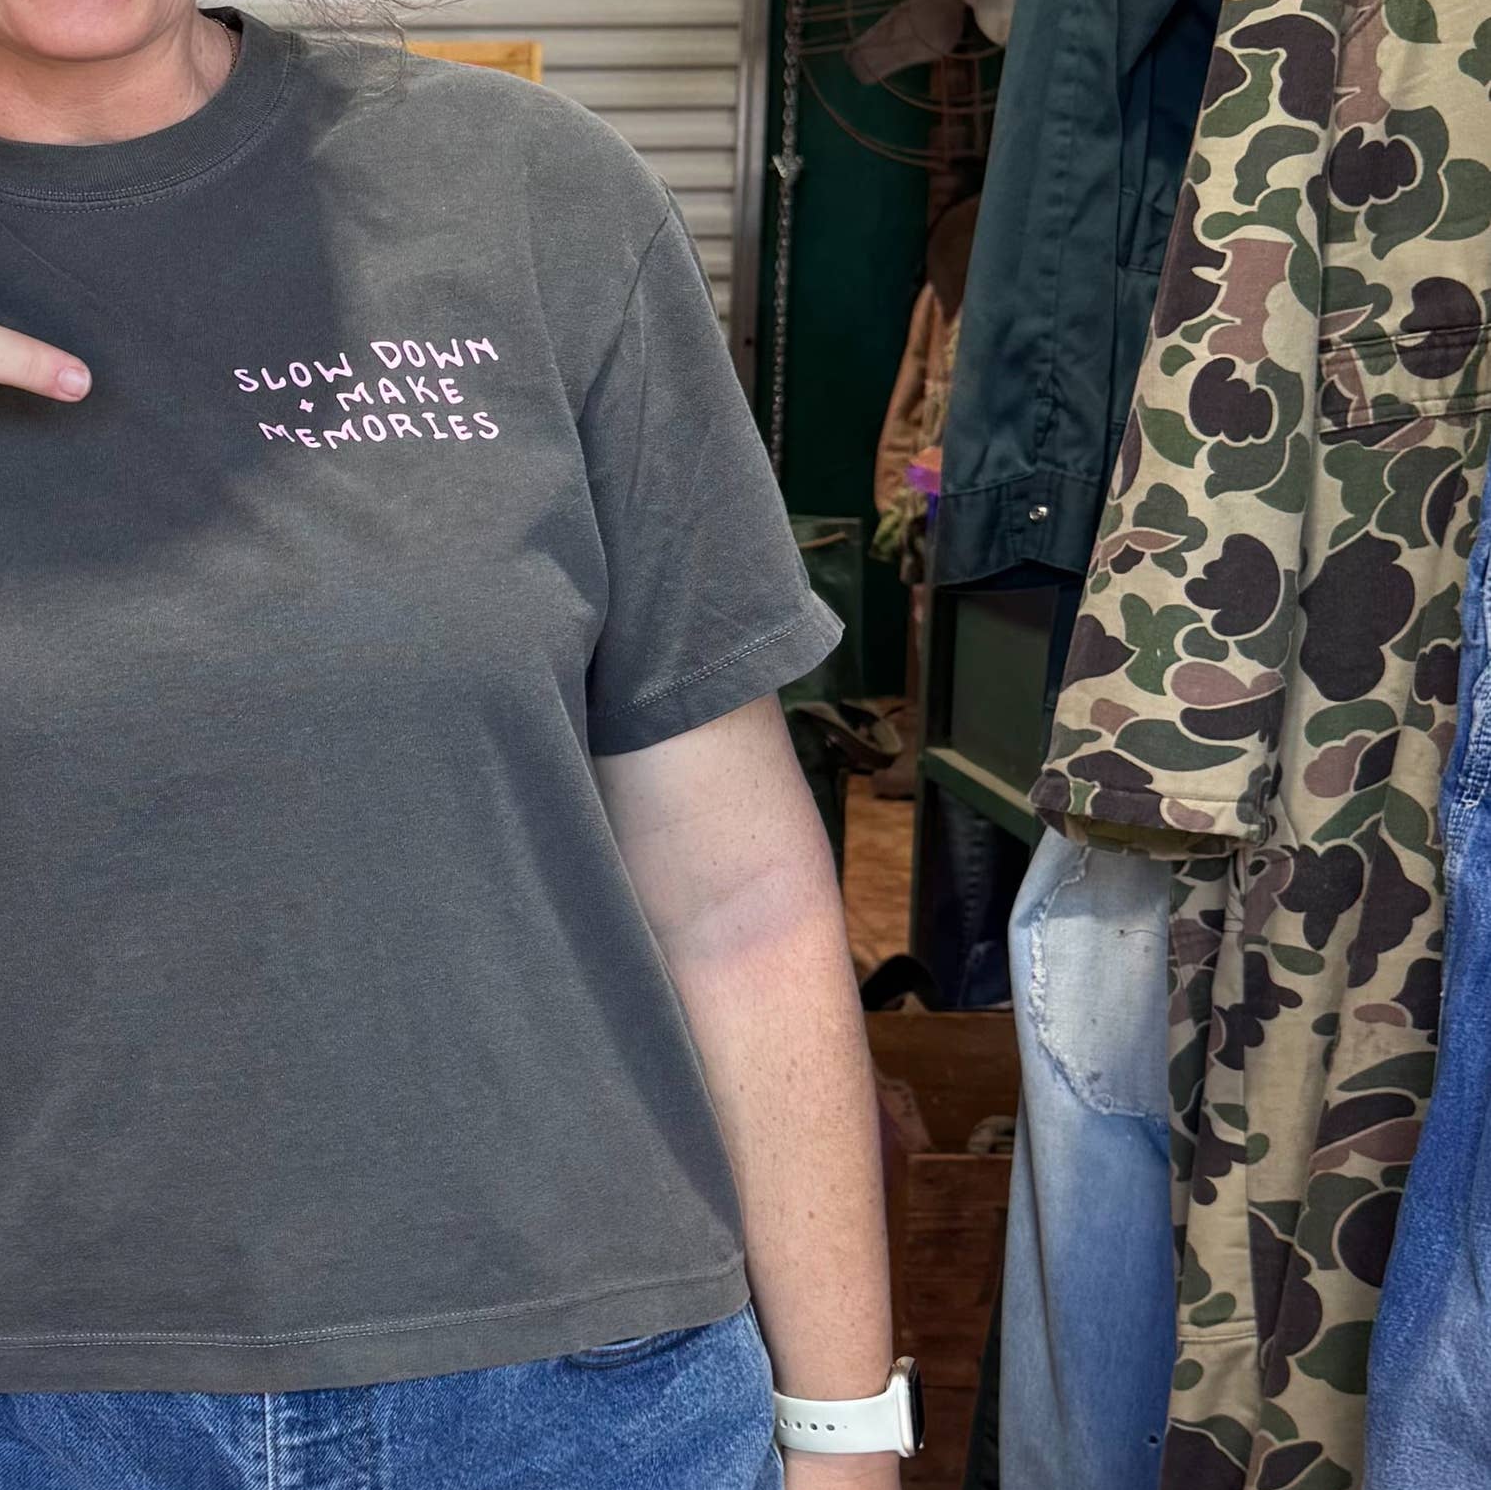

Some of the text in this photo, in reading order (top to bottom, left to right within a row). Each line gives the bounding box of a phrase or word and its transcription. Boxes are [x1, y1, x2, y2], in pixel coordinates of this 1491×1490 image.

[234, 337, 499, 392] SLOW DOWN
[336, 375, 464, 412] MAKE
[258, 411, 500, 450] MEMORIES
